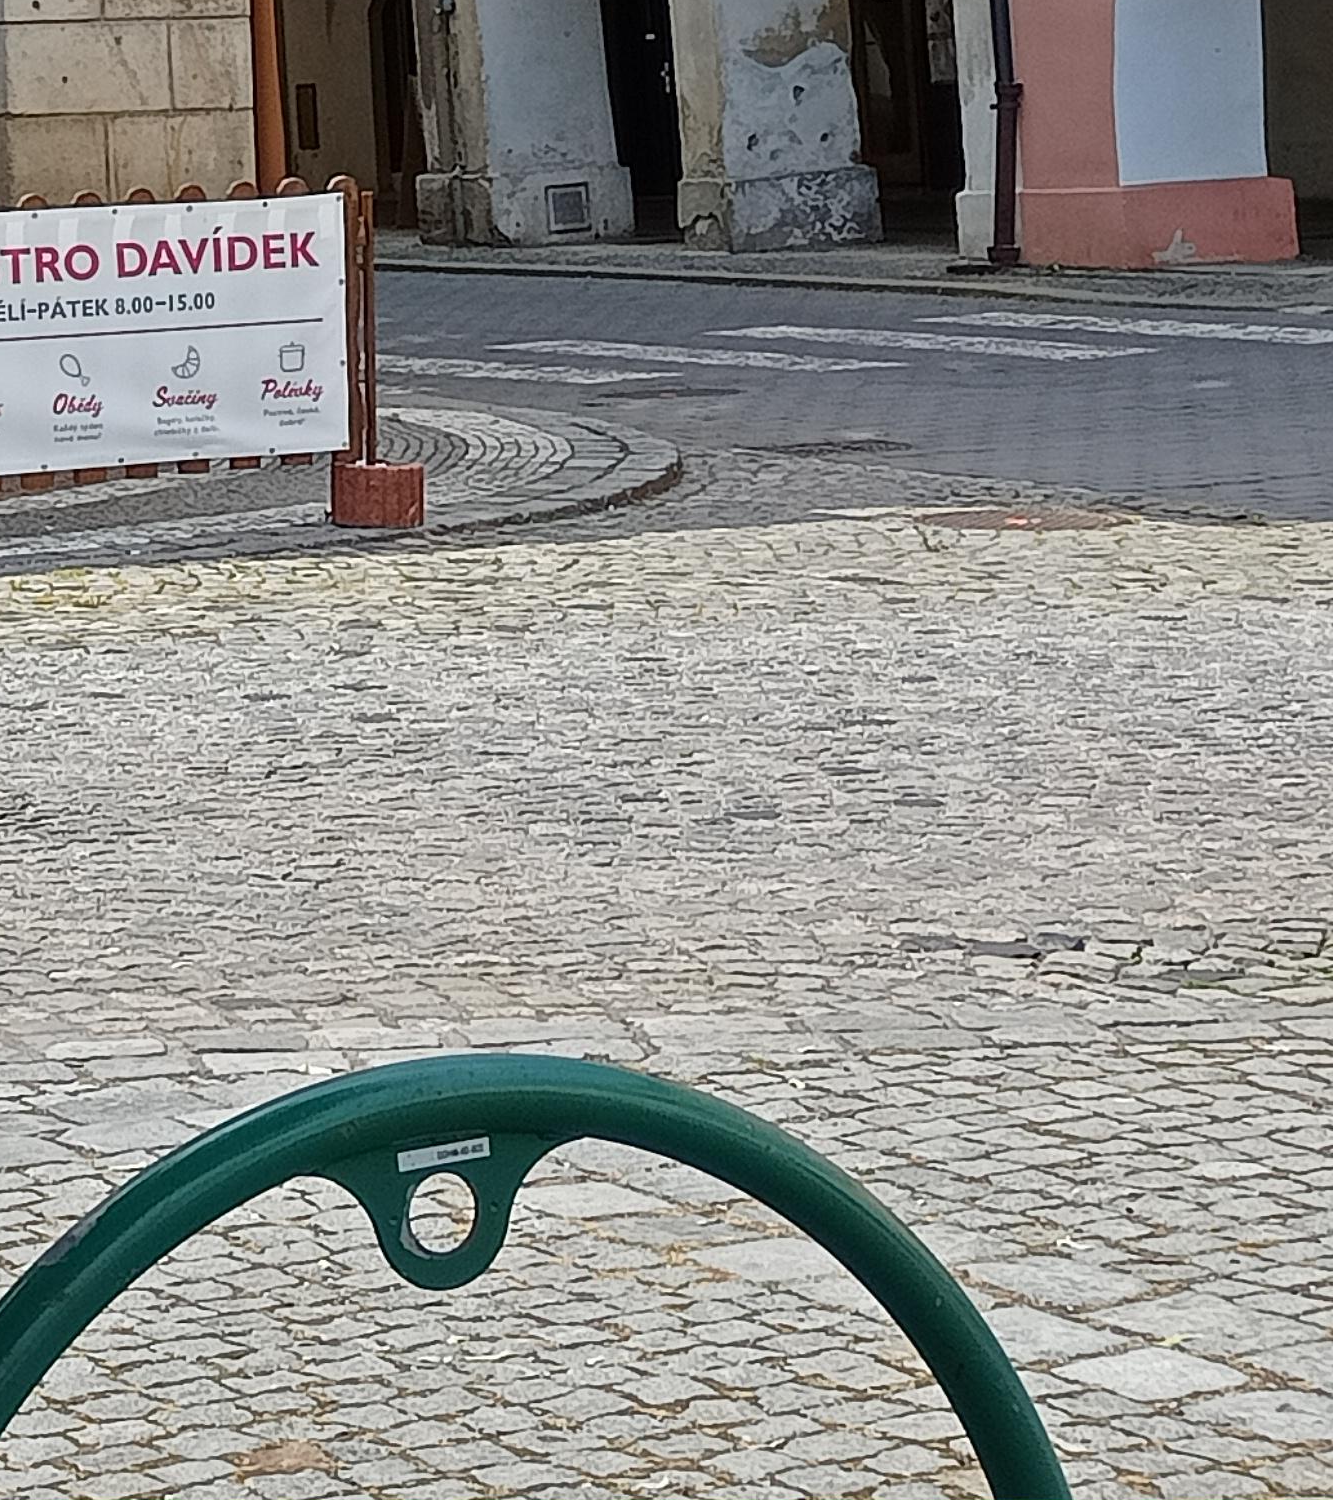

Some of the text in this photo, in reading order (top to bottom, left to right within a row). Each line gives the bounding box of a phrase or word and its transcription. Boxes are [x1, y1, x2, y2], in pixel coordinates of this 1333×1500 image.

[116, 226, 320, 278] DAVÍDEK
[152, 386, 218, 410] Svačiny
[261, 379, 324, 402] Polévky
[52, 393, 104, 417] Obědy
